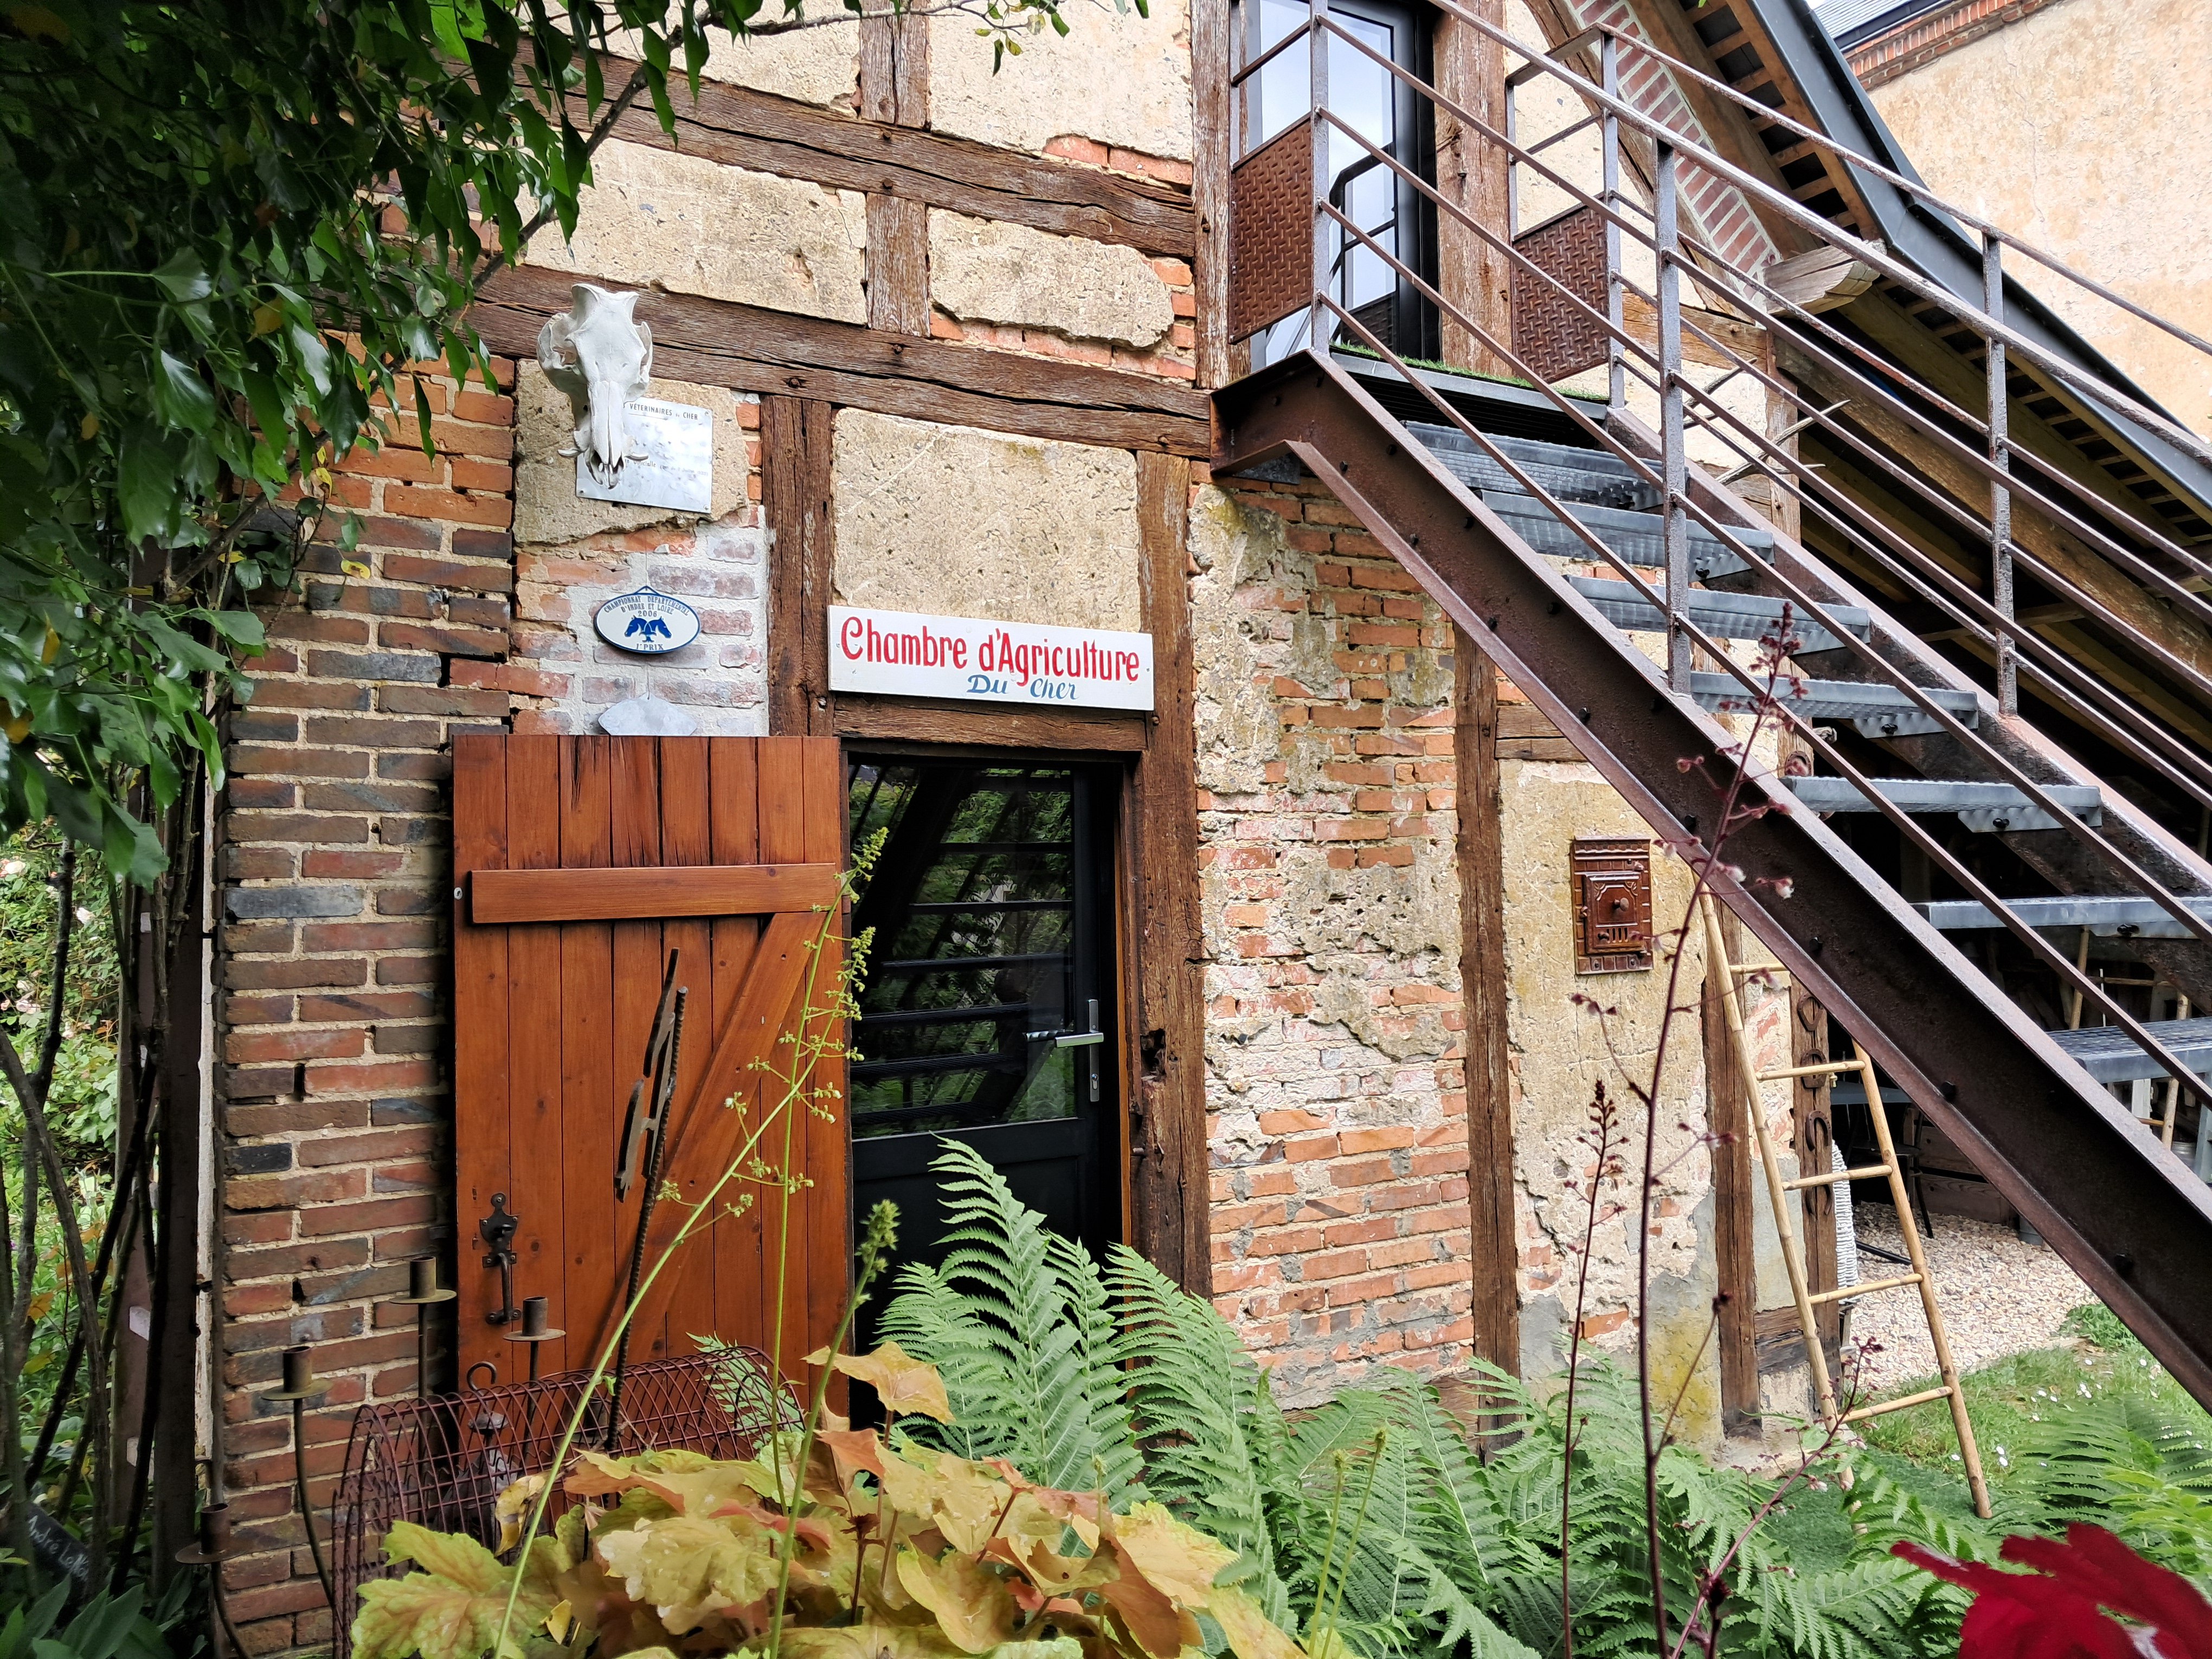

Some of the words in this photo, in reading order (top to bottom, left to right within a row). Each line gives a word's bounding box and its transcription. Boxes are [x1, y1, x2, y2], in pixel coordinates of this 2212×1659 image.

[683, 412, 698, 420] CHER
[603, 596, 641, 613] CHAMPIONNAT
[621, 603, 645, 613] D'INDRE
[657, 605, 674, 615] LOIRE
[840, 616, 968, 670] Chambre
[978, 627, 1140, 687] d'Agriculture
[966, 674, 1009, 695] Du
[1030, 678, 1079, 700] Cher
